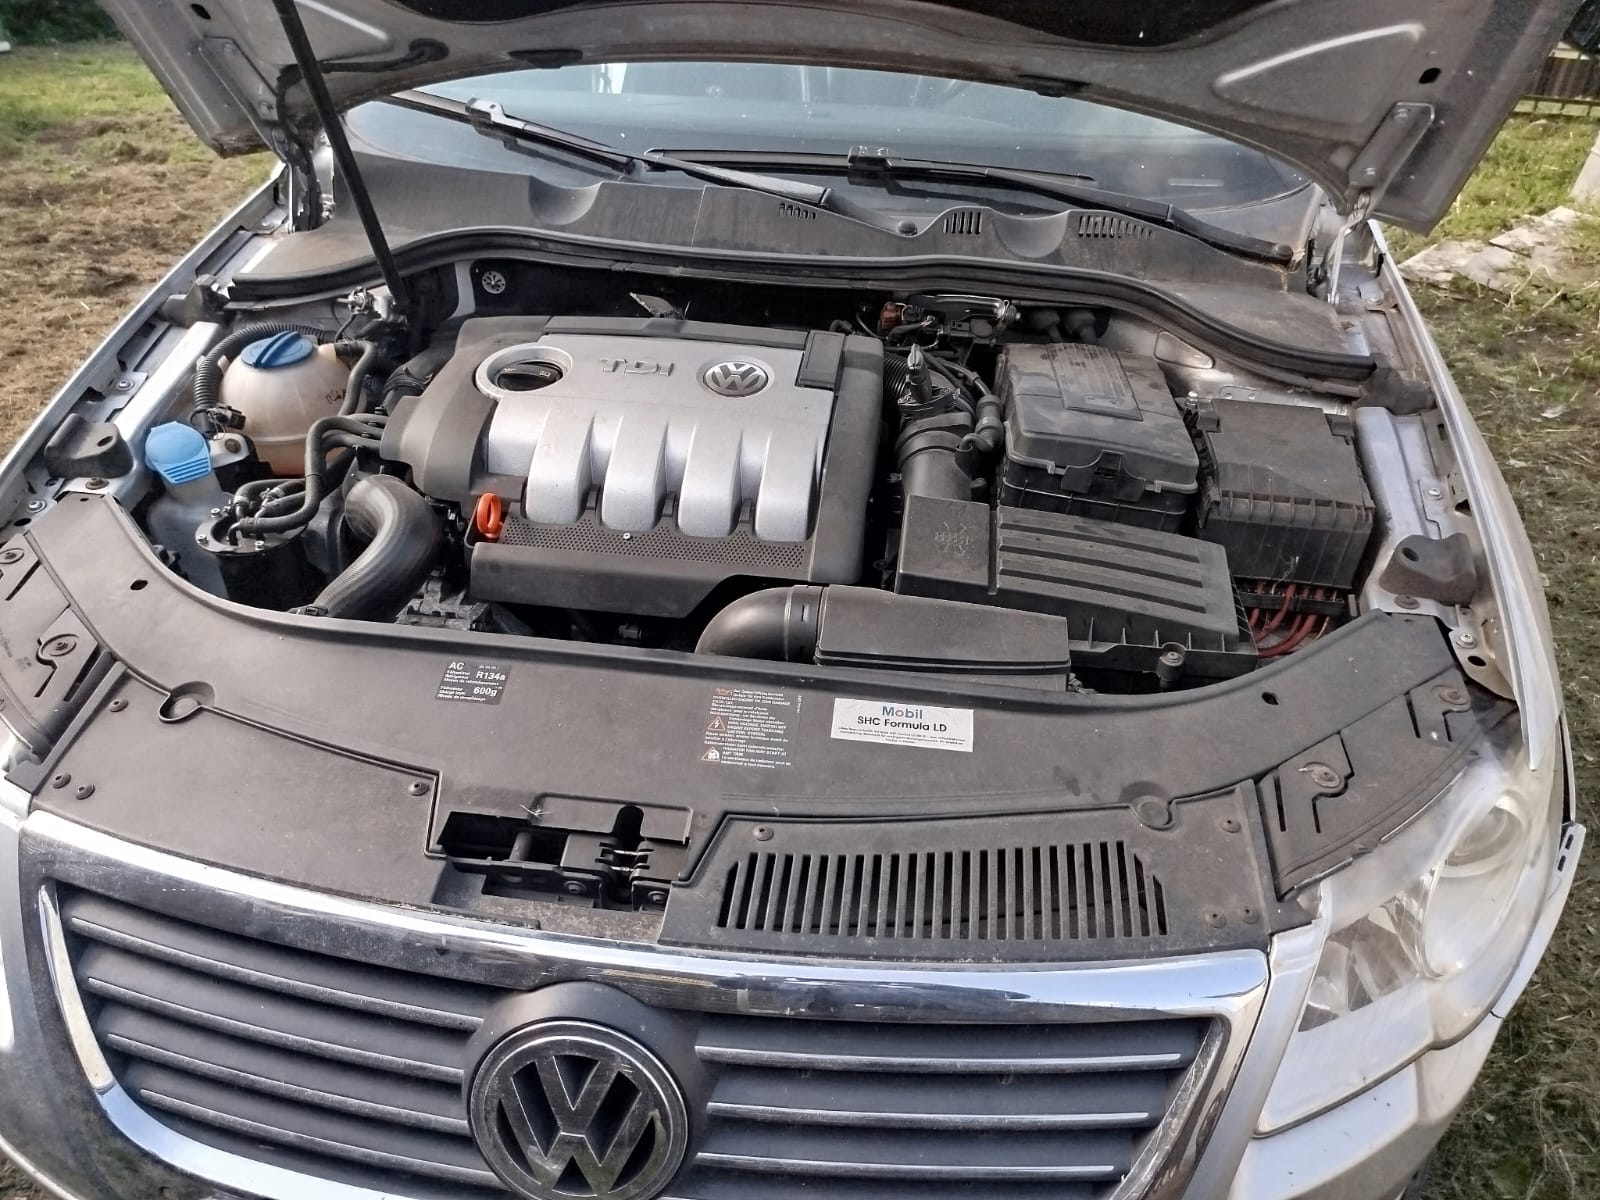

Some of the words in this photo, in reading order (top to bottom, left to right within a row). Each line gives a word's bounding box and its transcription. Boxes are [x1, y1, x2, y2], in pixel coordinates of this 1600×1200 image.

[600, 357, 675, 377] TDI
[448, 661, 465, 670] AC
[475, 670, 506, 681] R134a
[473, 686, 498, 697] 600g
[881, 706, 923, 720] Mobil
[857, 715, 881, 726] SHC
[884, 718, 930, 731] Formula
[933, 723, 948, 732] LD
